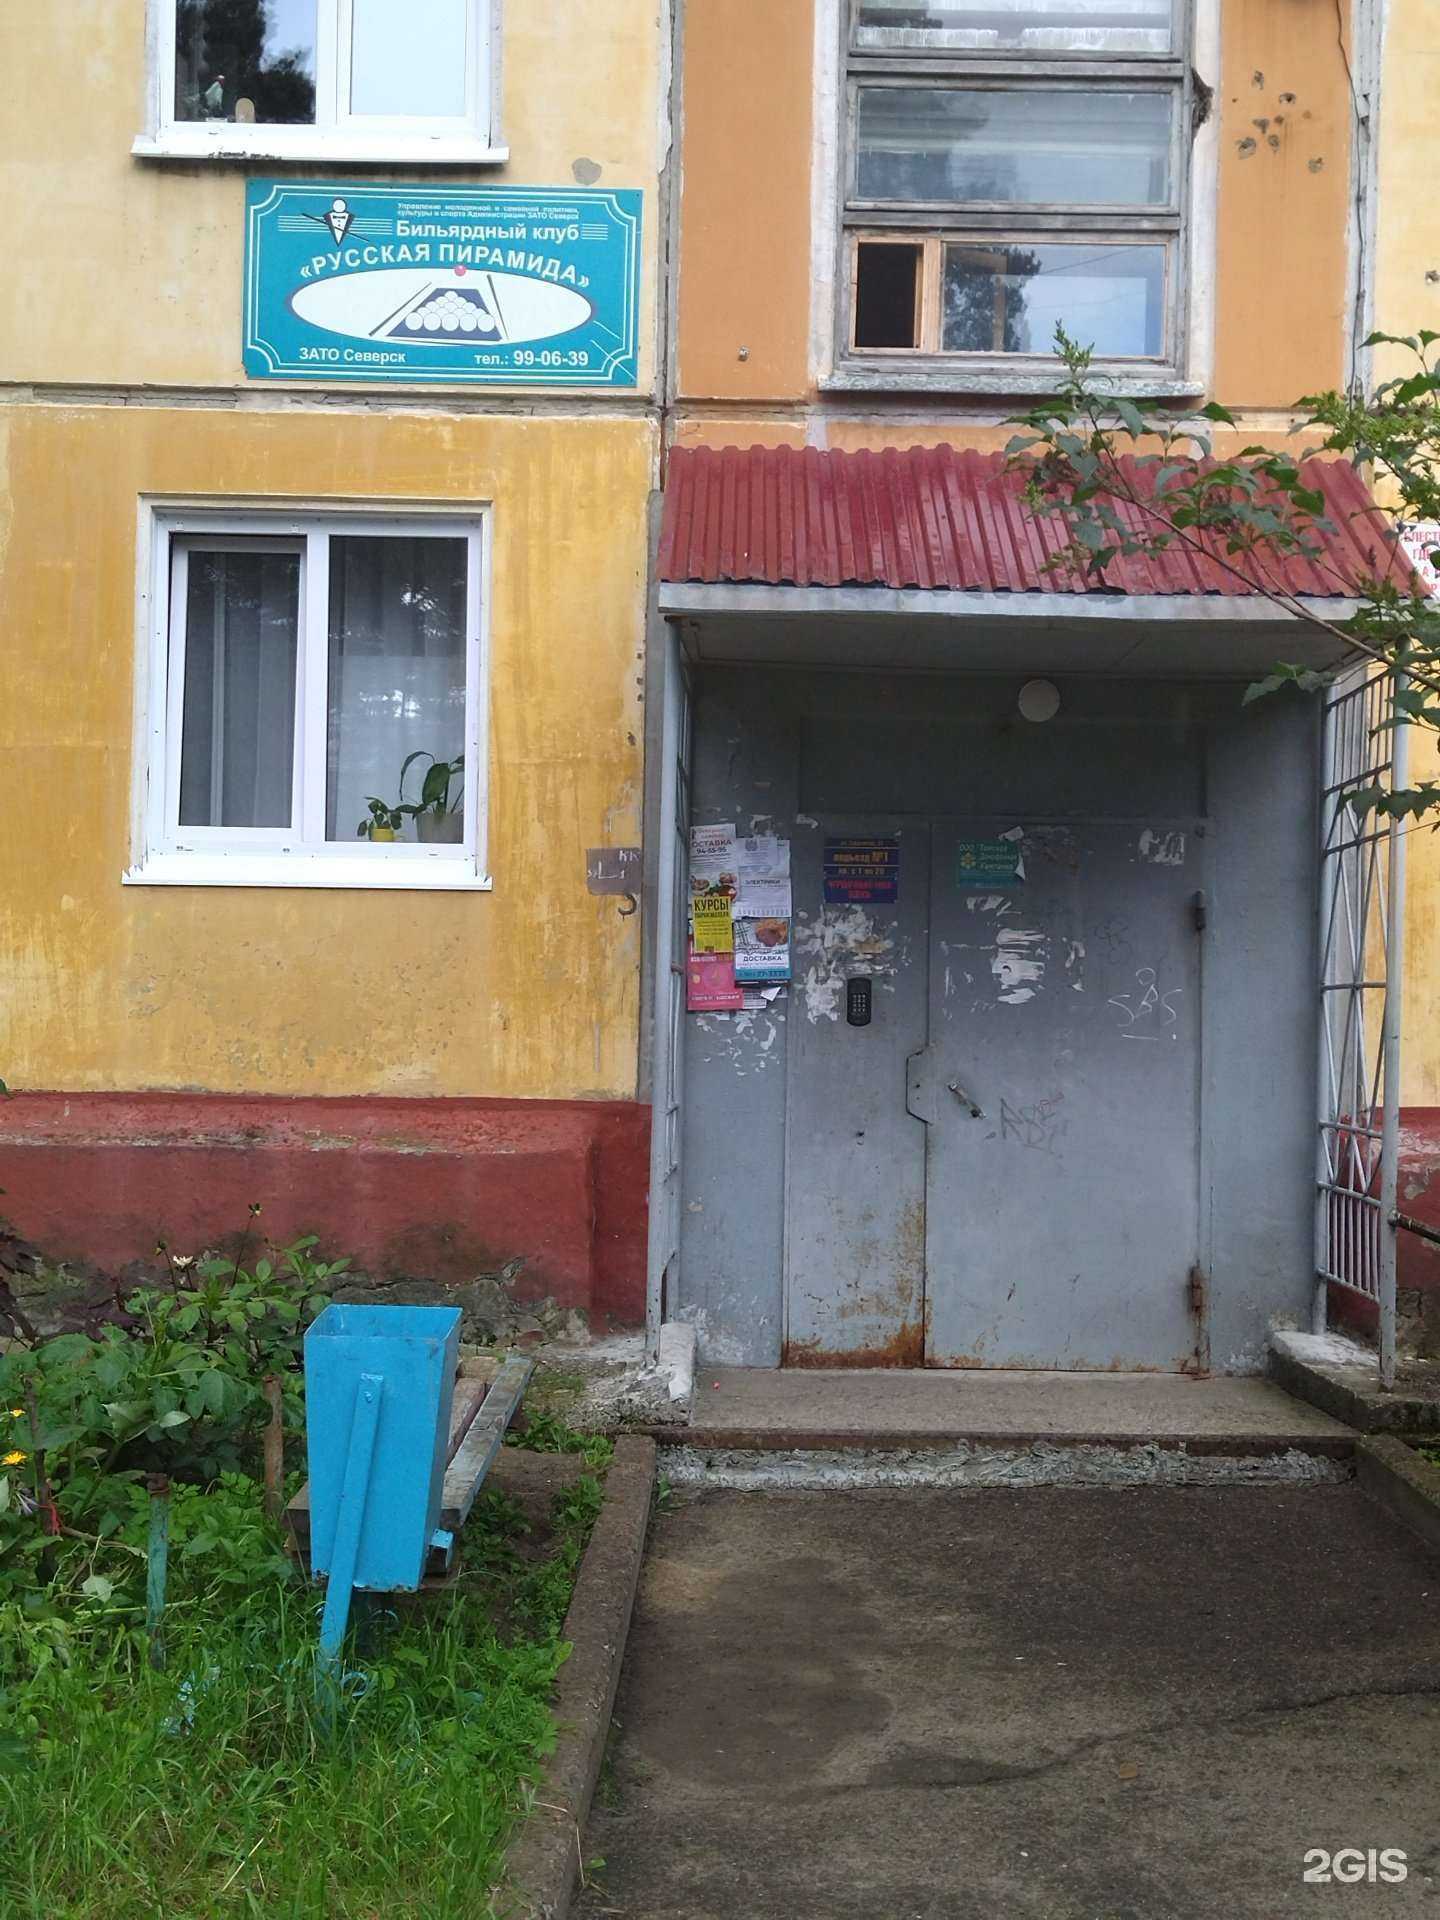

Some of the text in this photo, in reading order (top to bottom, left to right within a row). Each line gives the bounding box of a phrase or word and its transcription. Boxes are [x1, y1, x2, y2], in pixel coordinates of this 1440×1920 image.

[527, 212, 548, 220] ЗАТО
[549, 213, 580, 221] Северск
[396, 219, 580, 244] Бильярдный клуб
[299, 243, 591, 289] «РУССКАЯ ПИРАМИДА»
[299, 347, 406, 364] ЗАТО Северск
[474, 350, 590, 367] тел.: 99-06-39
[691, 839, 732, 849] ОСТАВКА
[694, 898, 729, 911] КУРСЫ
